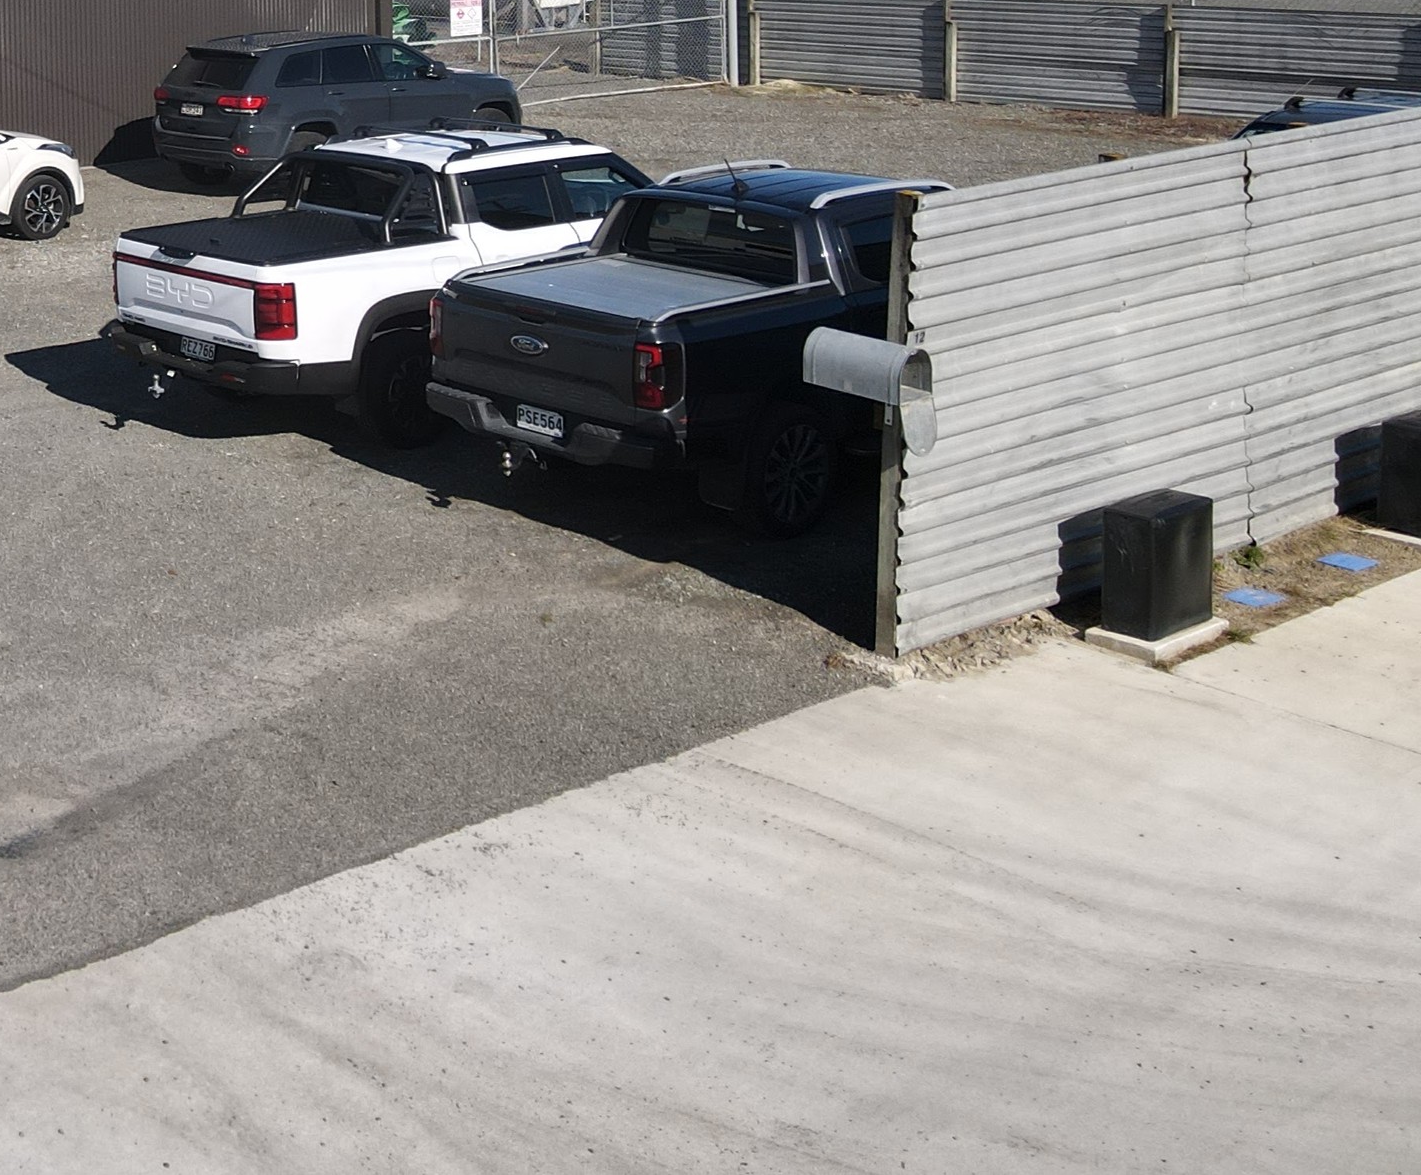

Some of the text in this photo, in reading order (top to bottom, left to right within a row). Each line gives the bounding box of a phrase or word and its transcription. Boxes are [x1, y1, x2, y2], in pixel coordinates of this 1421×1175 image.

[146, 273, 214, 309] BYD
[914, 331, 925, 343] 12
[518, 407, 562, 431] PSE564
